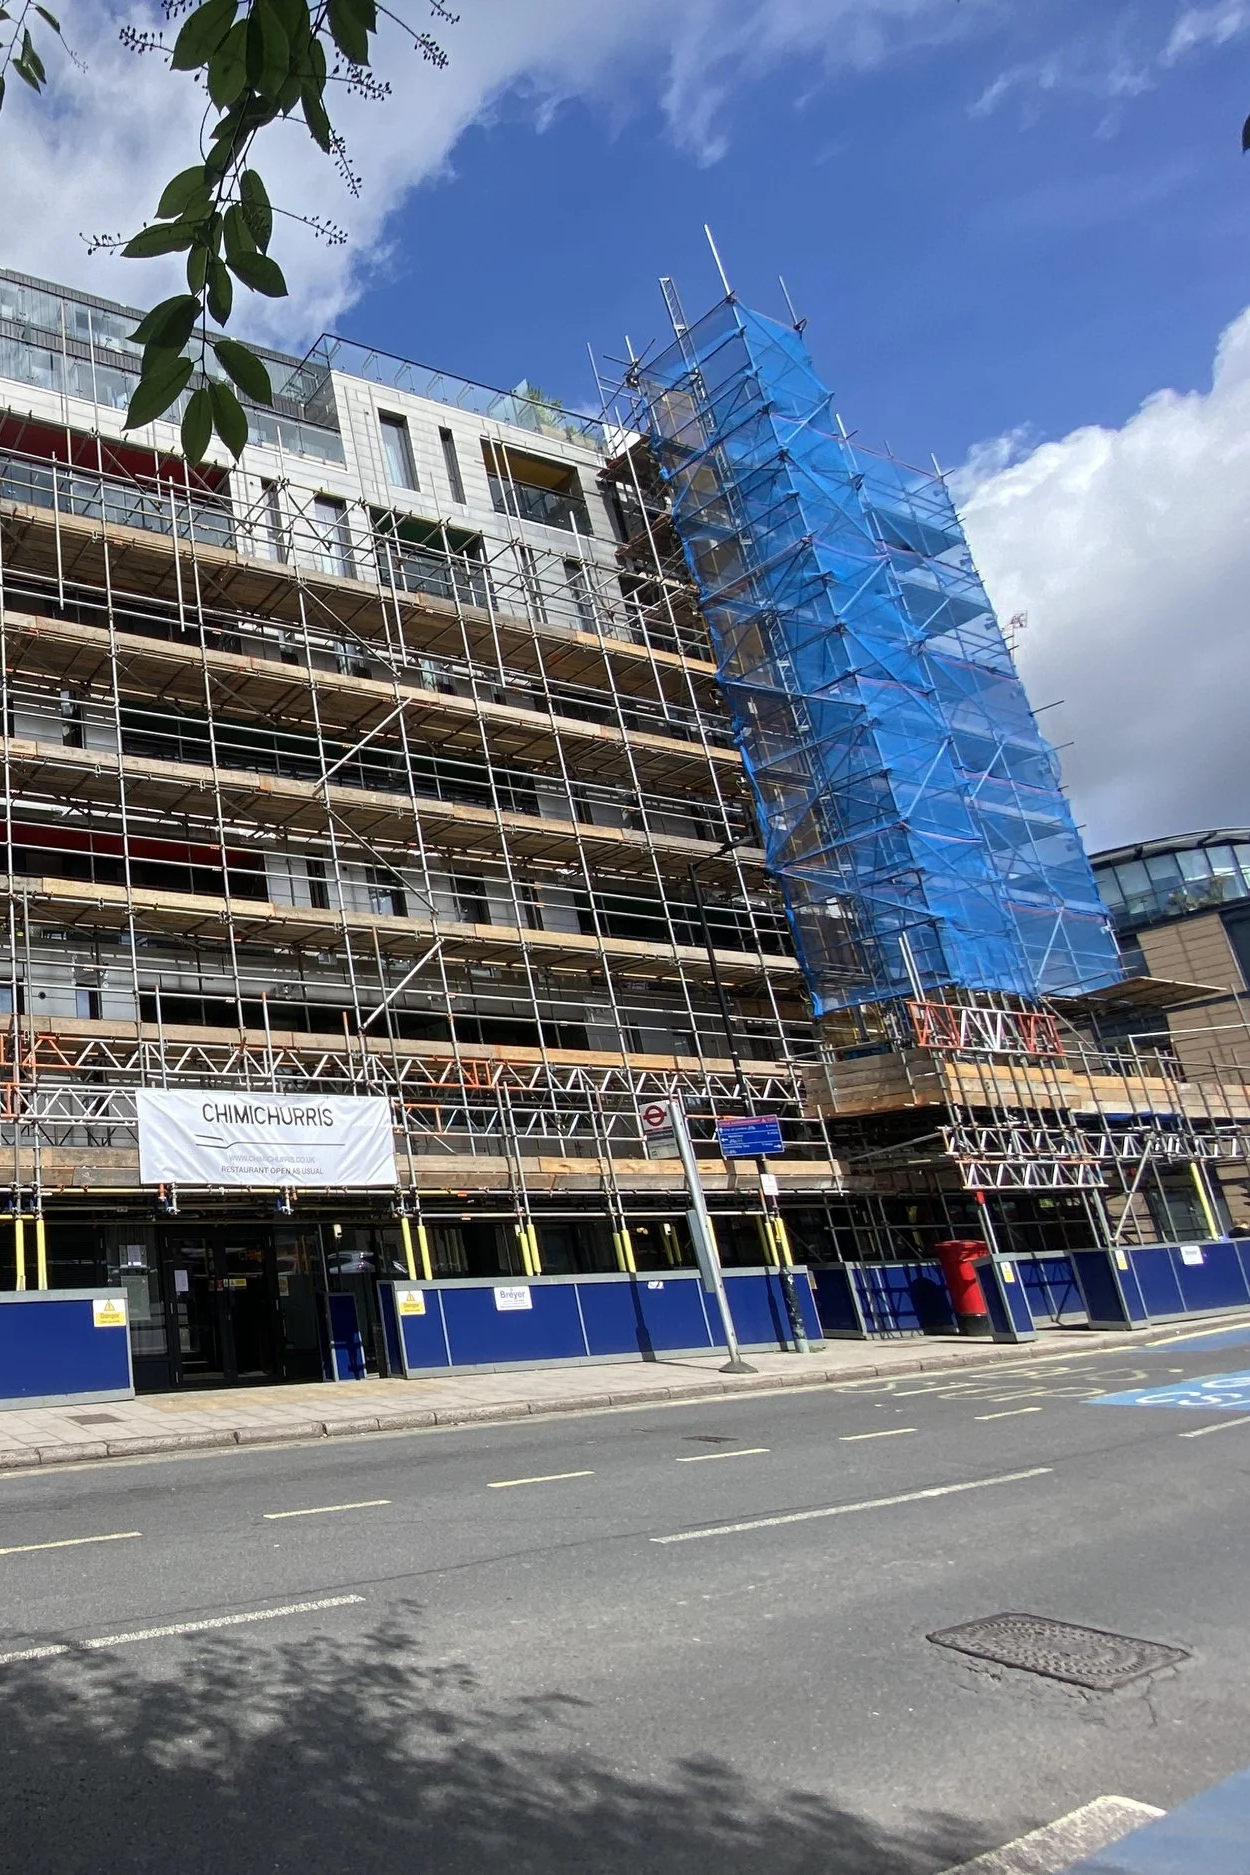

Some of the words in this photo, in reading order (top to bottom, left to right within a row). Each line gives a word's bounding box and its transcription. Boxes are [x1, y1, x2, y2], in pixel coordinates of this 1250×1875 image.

[202, 1103, 334, 1127] CHIMICHURRIS
[221, 1165, 268, 1174] RESTAURANT
[270, 1166, 291, 1175] OPEN
[292, 1167, 301, 1175] AS
[301, 1167, 324, 1175] USUAL
[500, 1290, 525, 1299] Breyer
[969, 1366, 1184, 1381] BUS
[834, 1380, 1107, 1402] STOP
